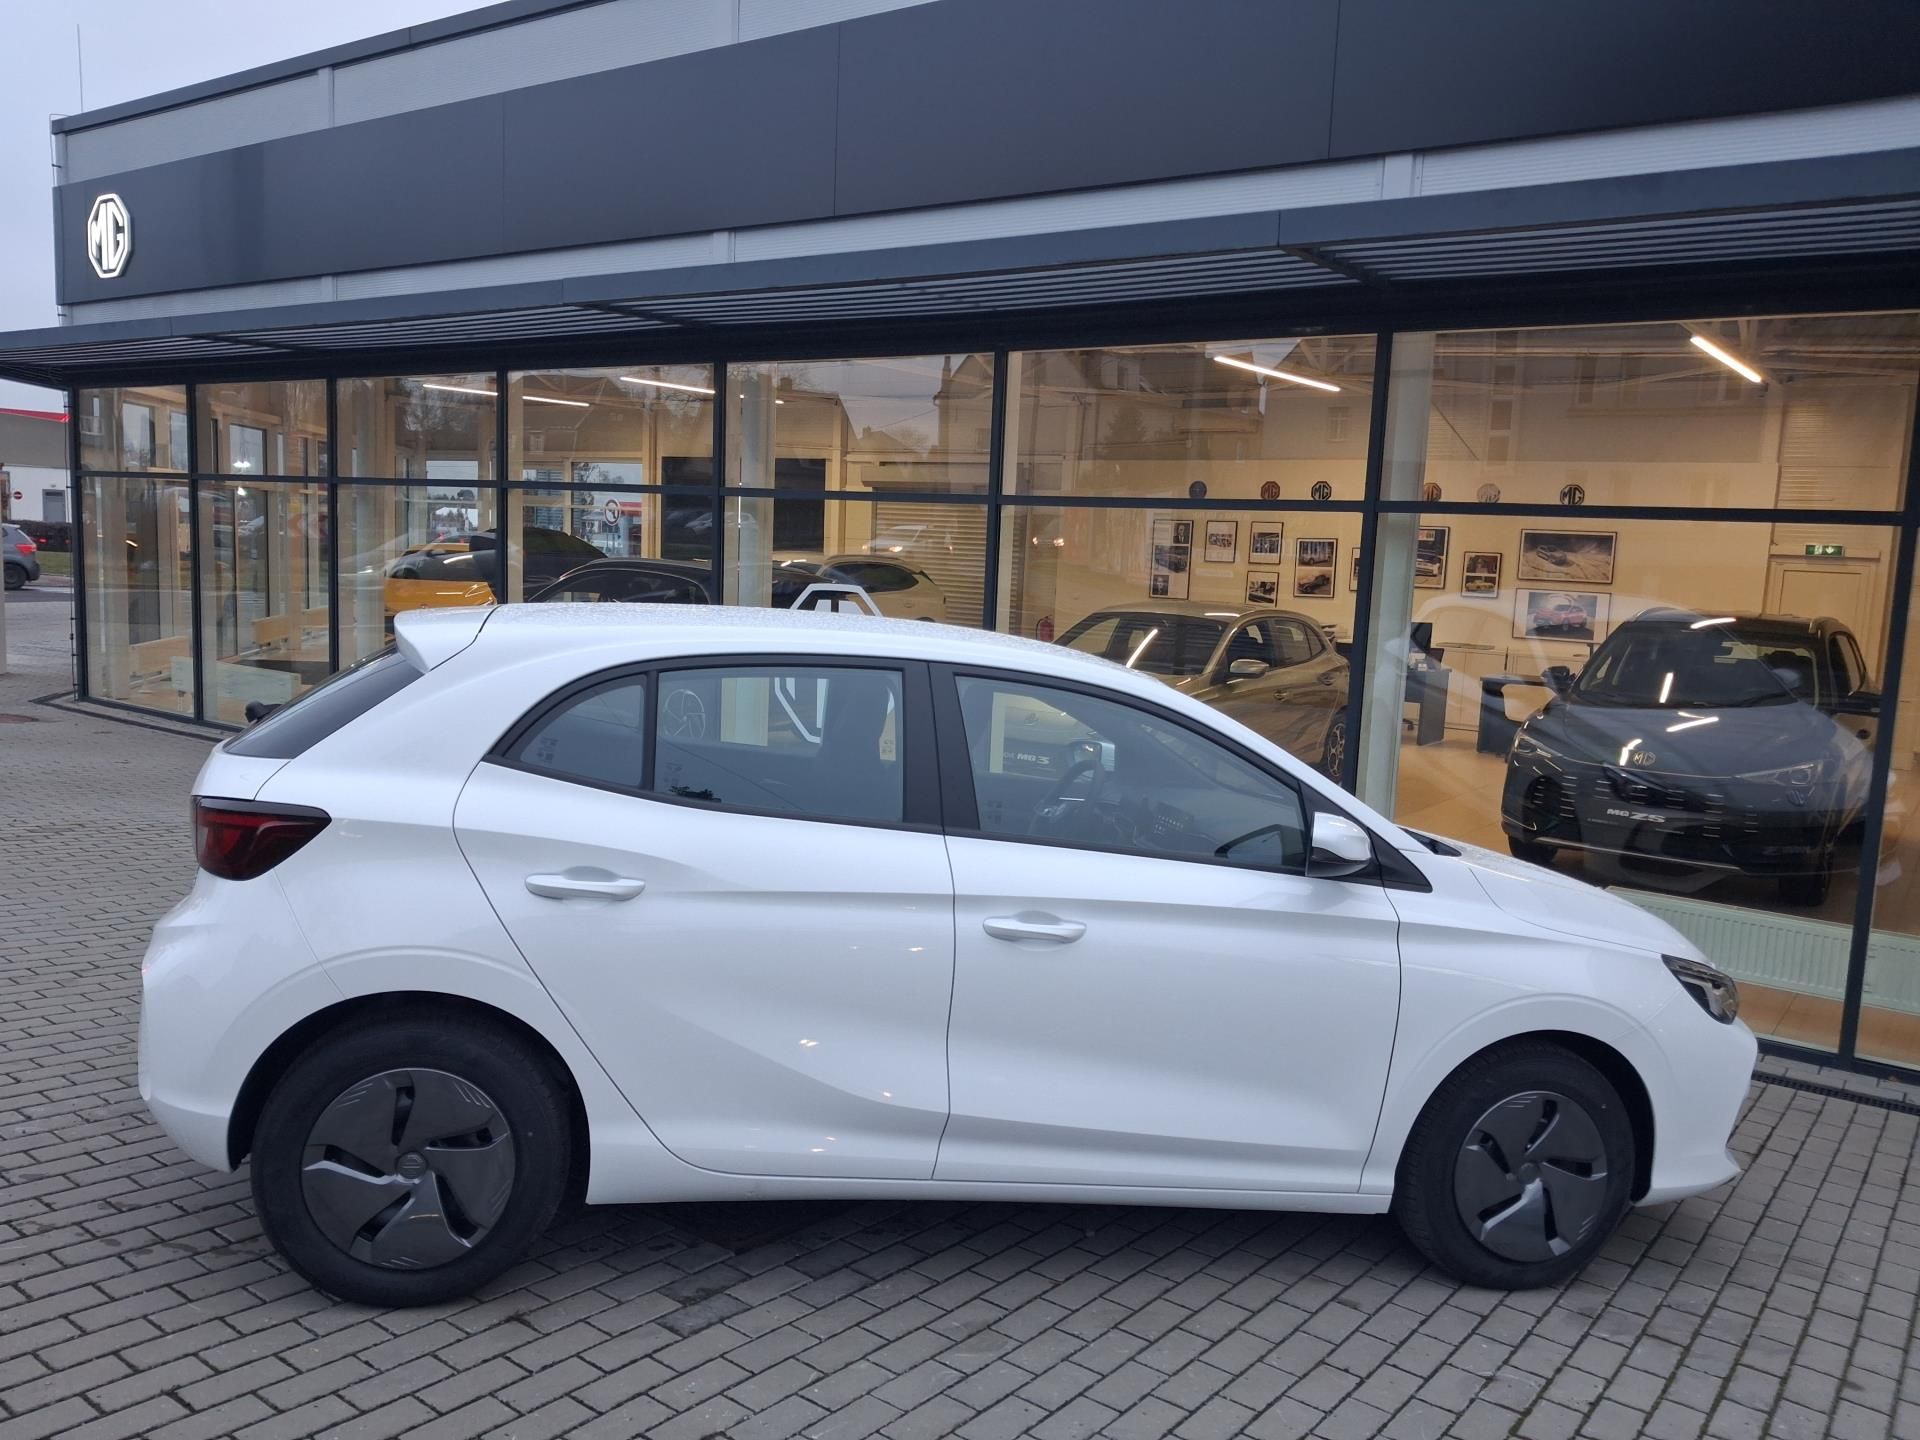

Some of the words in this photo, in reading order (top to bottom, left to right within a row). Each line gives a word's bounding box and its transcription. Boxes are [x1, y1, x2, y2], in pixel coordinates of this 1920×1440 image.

[90, 200, 126, 271] MG
[1262, 484, 1279, 499] MG
[1312, 484, 1330, 500] MG
[1560, 486, 1583, 504] MG
